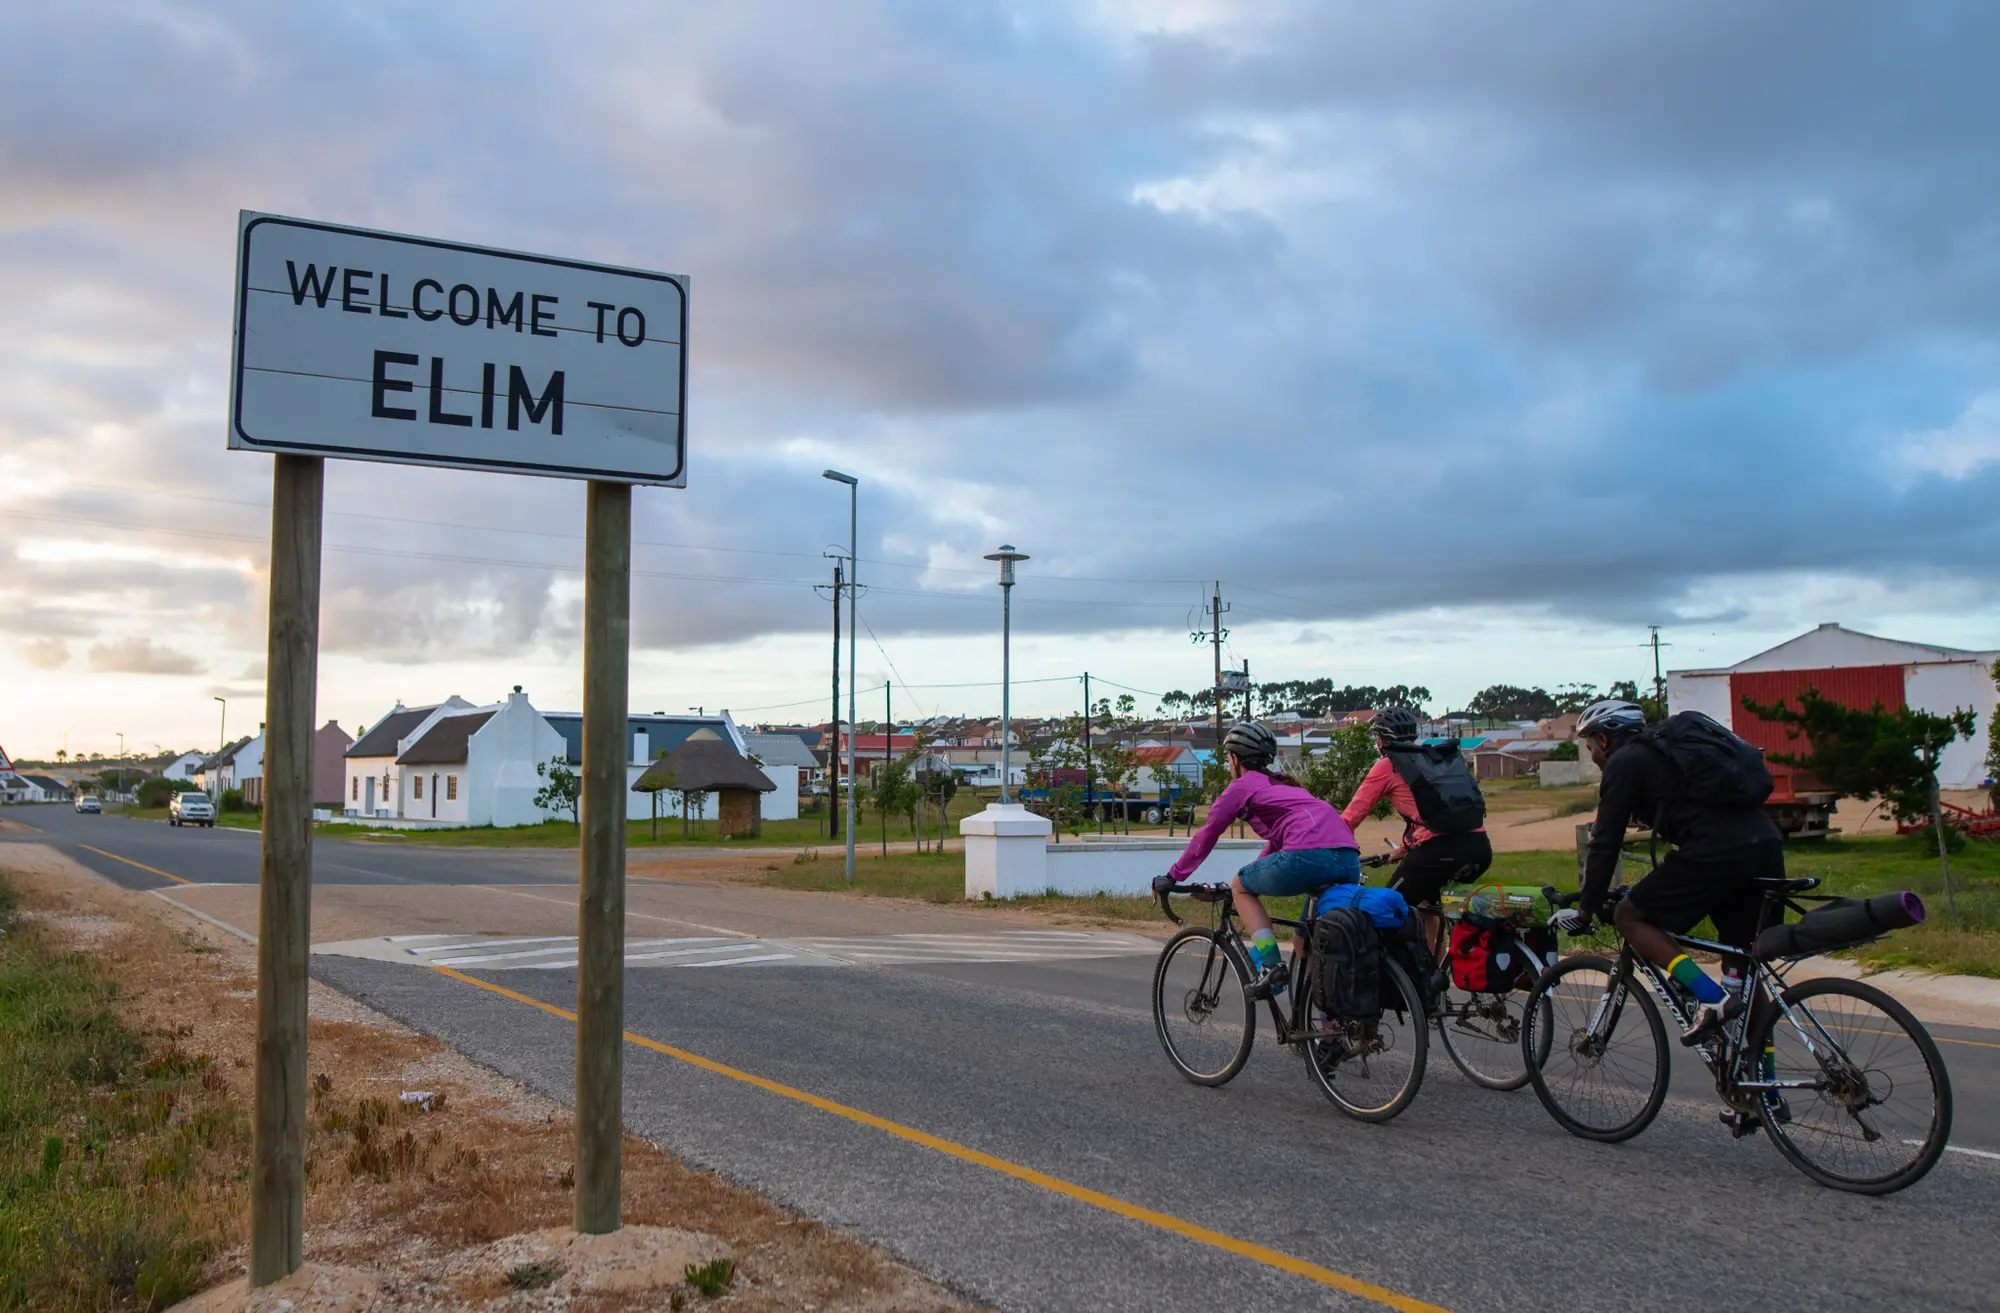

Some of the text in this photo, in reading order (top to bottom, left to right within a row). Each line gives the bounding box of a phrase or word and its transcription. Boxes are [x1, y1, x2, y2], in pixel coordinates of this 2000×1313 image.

[285, 259, 646, 348] WELCOME TO
[371, 349, 565, 436] ELIM
[1642, 965, 1713, 1062] cannonle
